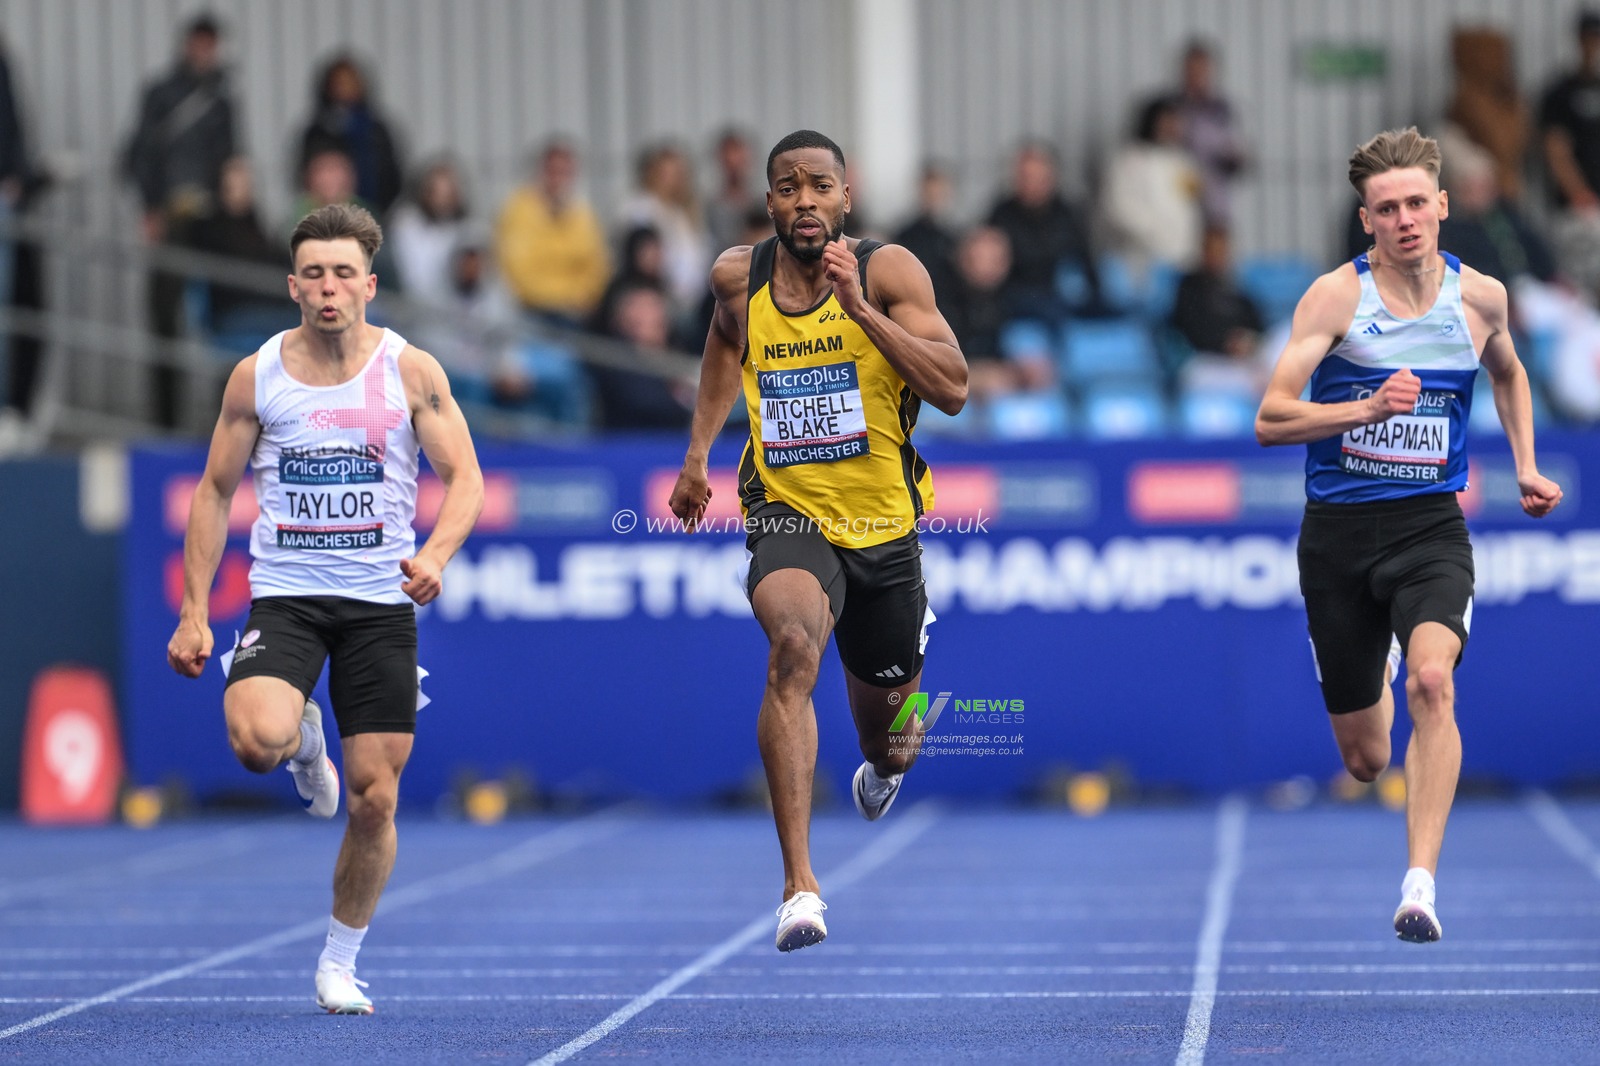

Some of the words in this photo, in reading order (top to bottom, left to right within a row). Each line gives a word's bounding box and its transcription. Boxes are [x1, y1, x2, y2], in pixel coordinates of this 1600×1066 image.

[764, 335, 843, 360] NEWHAM
[761, 367, 850, 394] Microplus
[775, 386, 816, 395] PROCESSING
[826, 382, 850, 391] TIMING
[766, 394, 853, 420] MITCHELL
[775, 440, 806, 448] ATHLETICS
[807, 433, 860, 445] CHAMPIONSHIPS
[777, 416, 840, 441] BLAKE
[1349, 421, 1443, 451] CHAPMAN
[768, 441, 861, 464] MANCHESTER
[284, 458, 377, 484] Microplus
[301, 475, 341, 483] PROCESSING
[1345, 456, 1439, 480] MANCHESTER
[286, 491, 376, 519] TAYLOR
[282, 531, 376, 548] MANCHESTER
